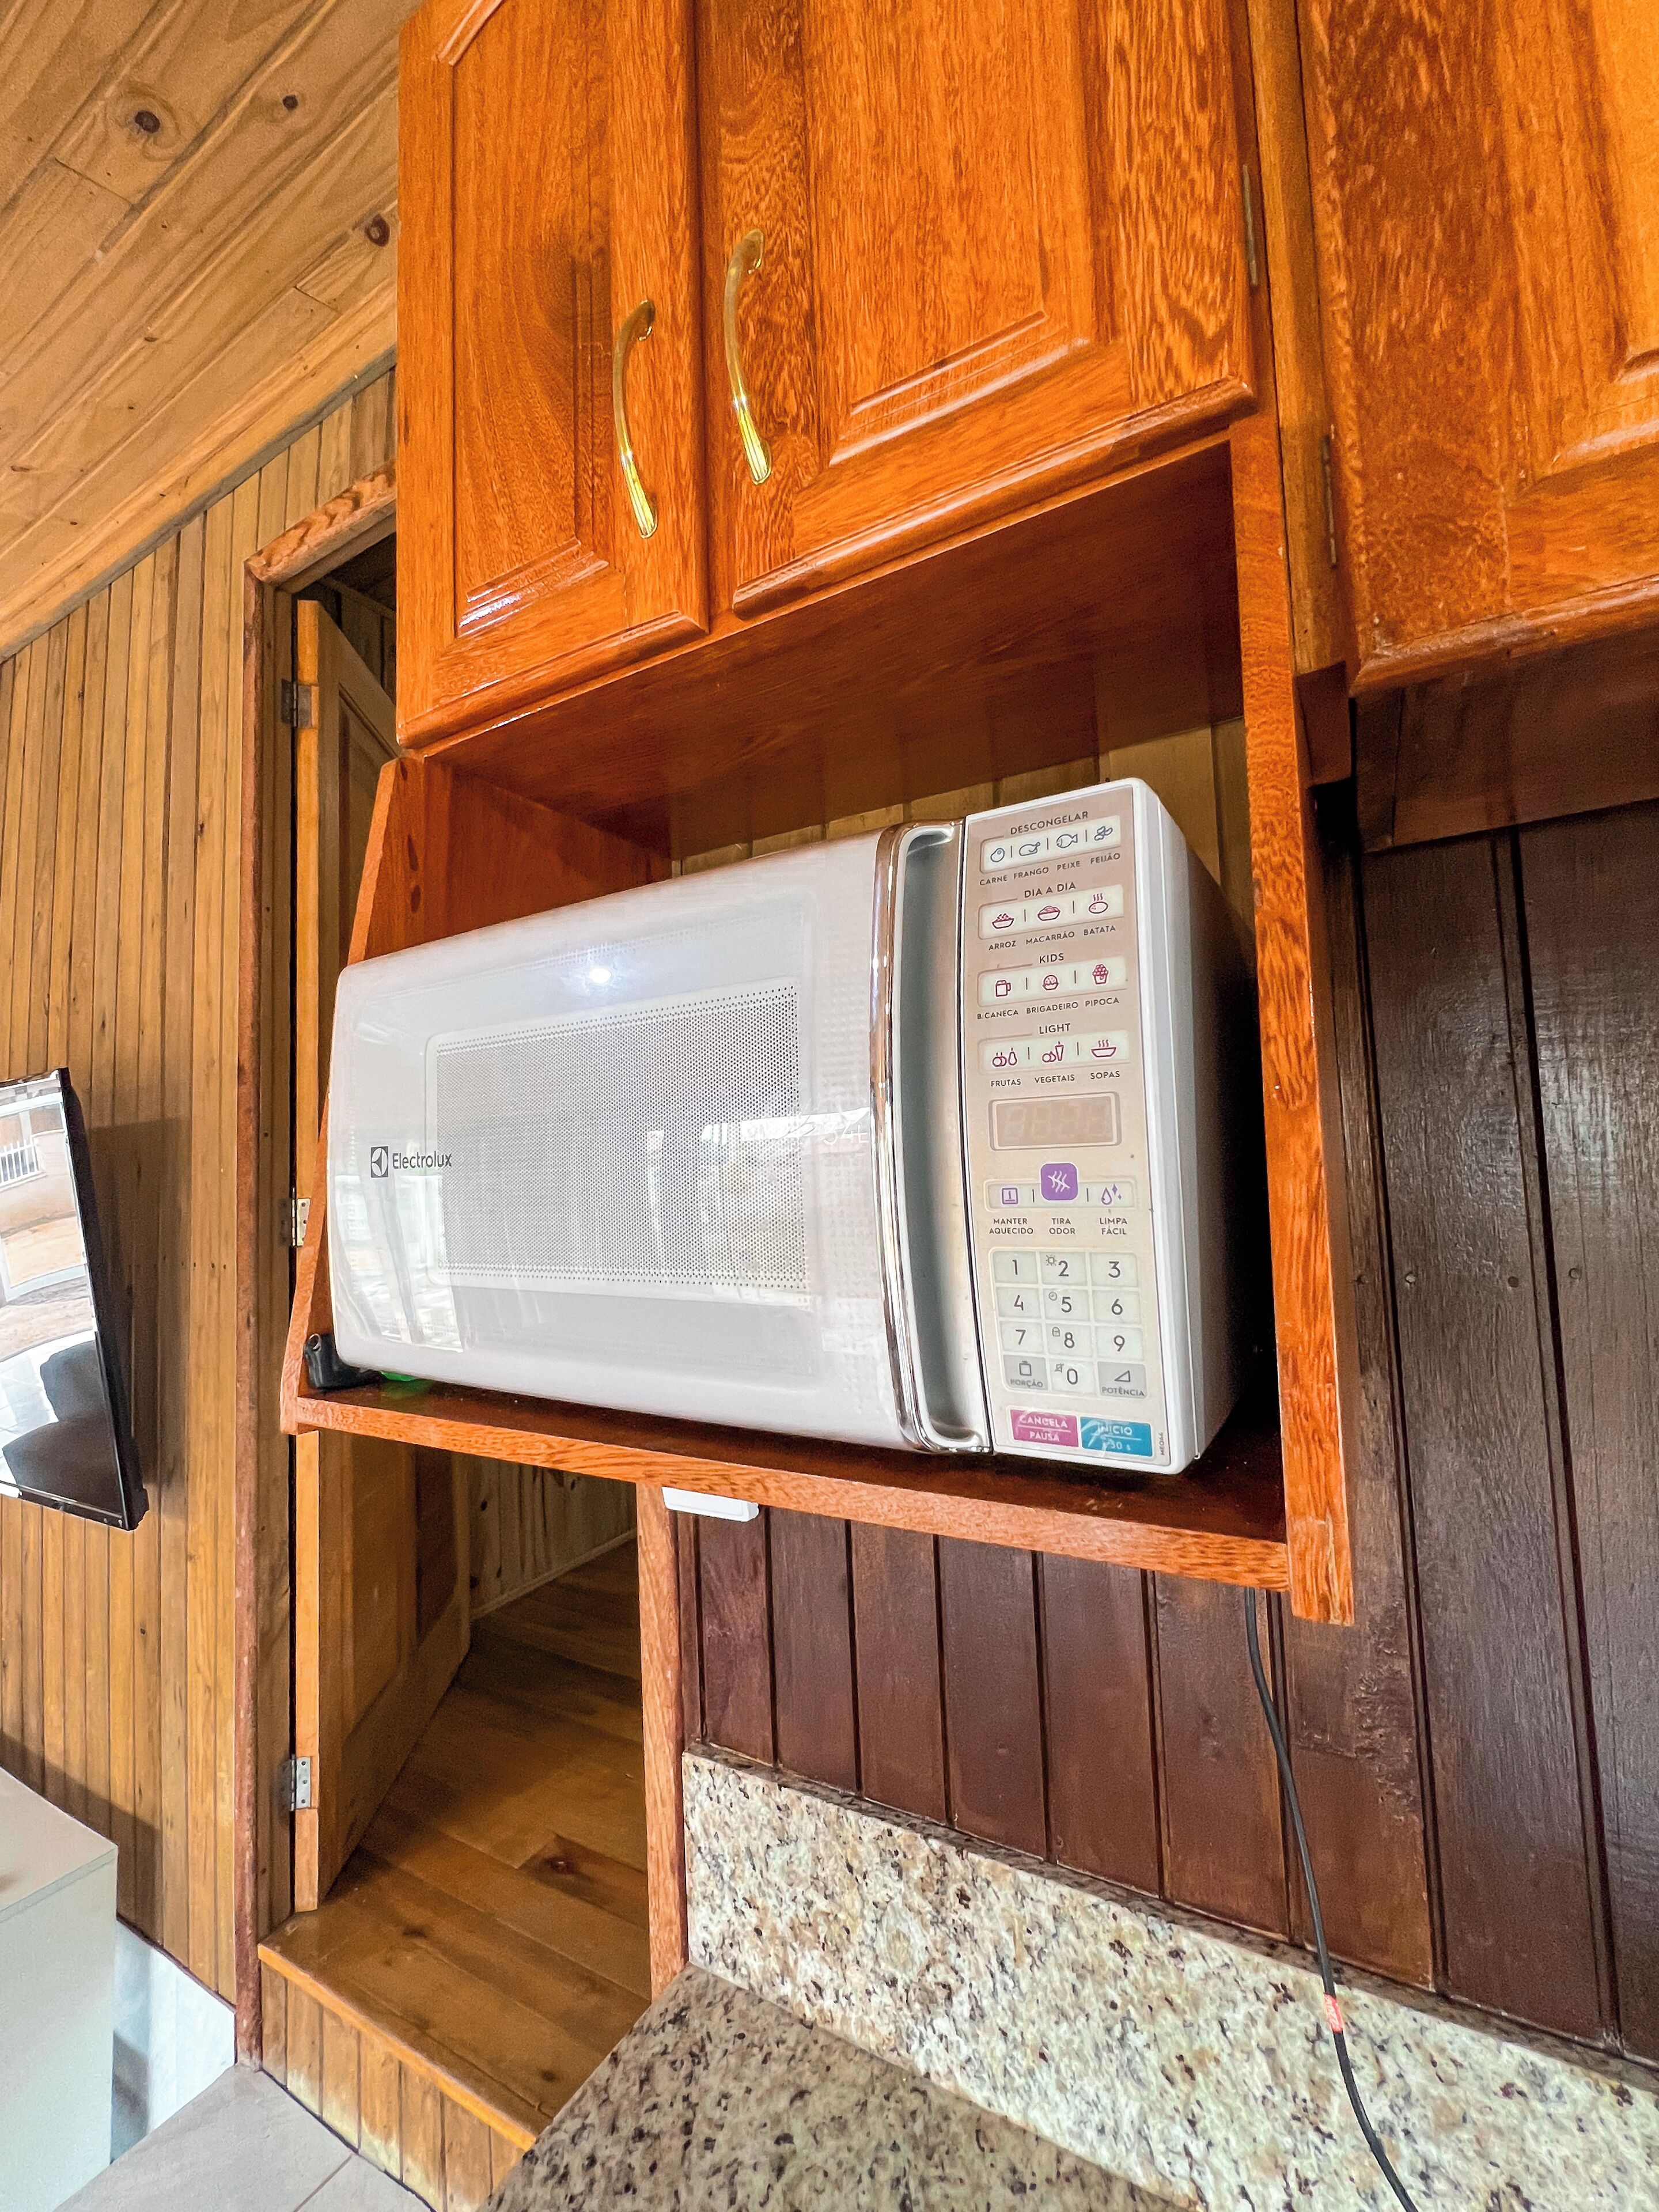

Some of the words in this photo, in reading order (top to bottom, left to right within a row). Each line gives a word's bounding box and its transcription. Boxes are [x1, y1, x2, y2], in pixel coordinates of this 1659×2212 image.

[1011, 811, 1088, 835] DESCONGELAR
[980, 875, 1007, 885] CARNE
[1014, 867, 1049, 879] FRANGO
[1057, 861, 1080, 870] PEIXE
[1090, 853, 1120, 864] FEIJÃO
[1024, 889, 1042, 898] DIA
[1057, 882, 1076, 892] DIA
[988, 940, 1016, 950] ARROZ
[1026, 930, 1074, 944] MACARRÃO
[1084, 925, 1116, 935] BATATA
[1039, 953, 1064, 963] KIDS
[984, 1009, 1018, 1018] CANECA
[1026, 1002, 1078, 1014] BRIGADEIRO
[1085, 997, 1119, 1007] PIPOCA
[1039, 1023, 1071, 1034] LIGHT
[991, 1078, 1021, 1087] FRUTAS
[1035, 1074, 1075, 1083] VEGETAIS
[1090, 1071, 1120, 1080] SOPAS
[392, 1150, 452, 1169] Electrolux
[1101, 1225, 1127, 1235] FÁCIL
[1012, 1259, 1018, 1275] 1
[1058, 1260, 1069, 1277] 2
[1108, 1261, 1121, 1278] 3
[1013, 1295, 1024, 1310] 4
[1060, 1297, 1072, 1313] 5
[1111, 1299, 1123, 1315] 6
[1016, 1330, 1026, 1345] 7
[1064, 1332, 1075, 1349] 8
[1113, 1335, 1125, 1351] 9
[1067, 1368, 1078, 1385] 0
[1101, 1387, 1145, 1396] POTÊNCIA
[1019, 1415, 1067, 1428] CANCELA
[1029, 1431, 1060, 1442] PAUSA
